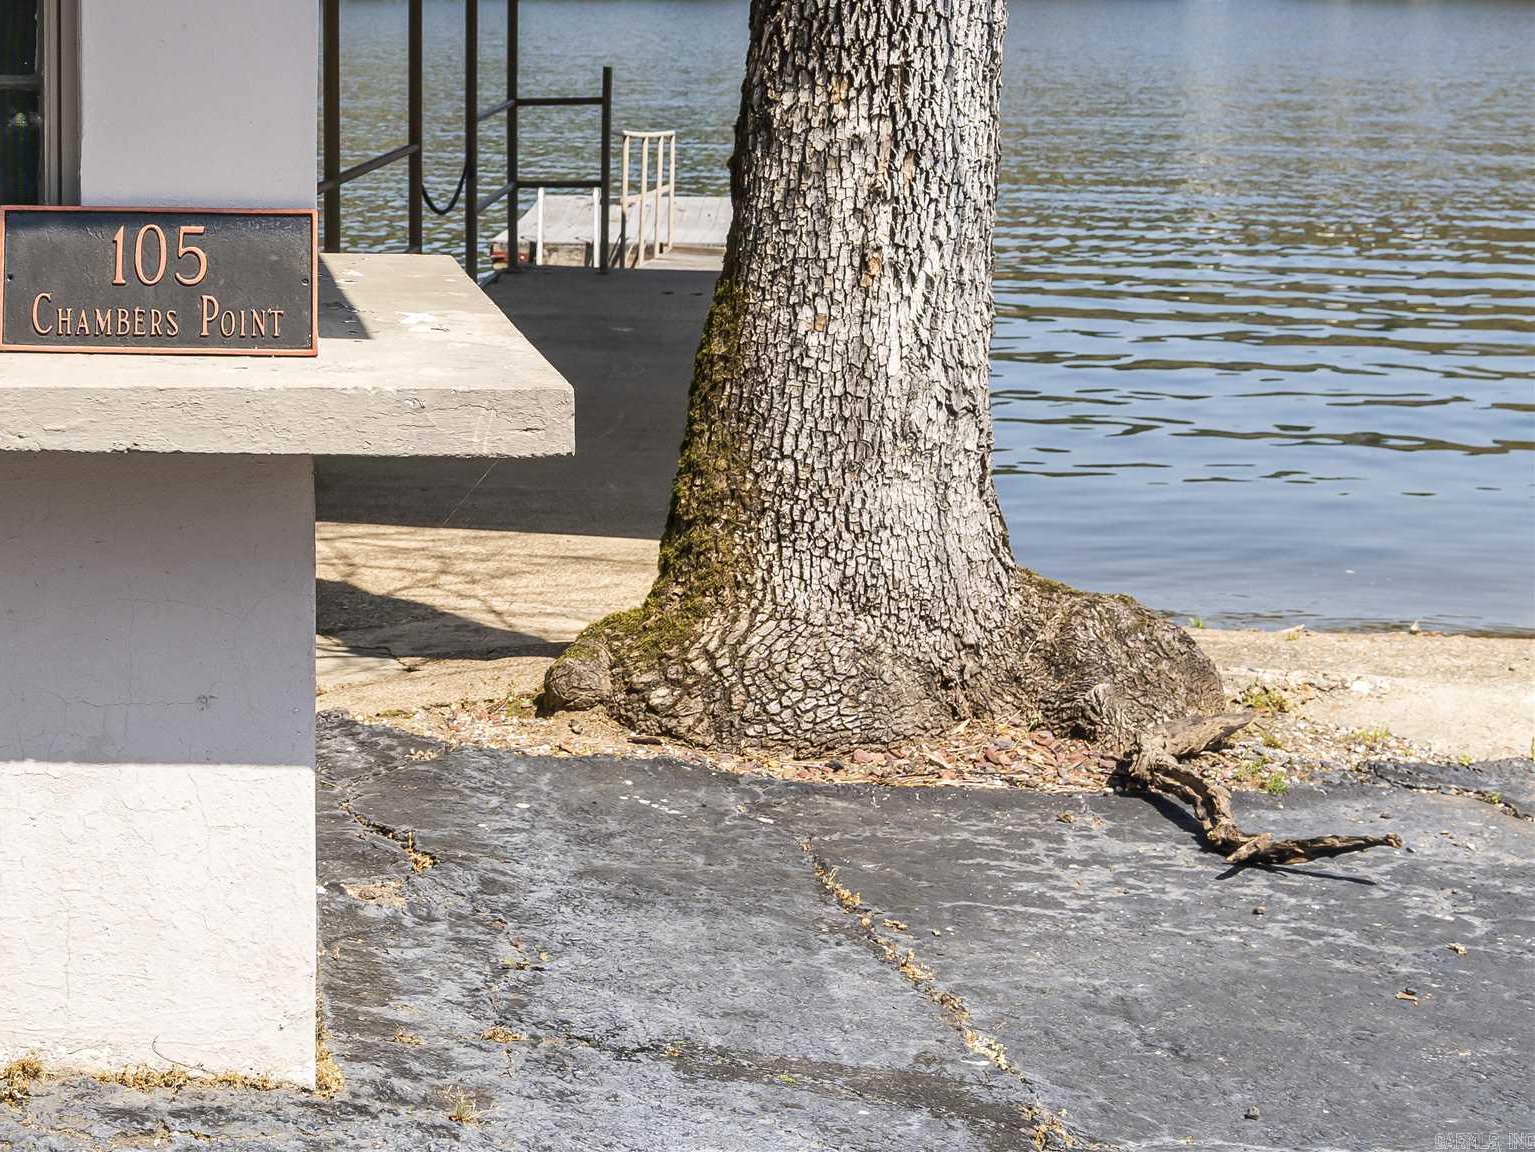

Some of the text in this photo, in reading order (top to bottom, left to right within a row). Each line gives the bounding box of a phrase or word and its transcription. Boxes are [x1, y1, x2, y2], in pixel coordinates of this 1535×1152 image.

[112, 223, 208, 287] 105
[31, 292, 284, 339] CHAMBERS POINT
